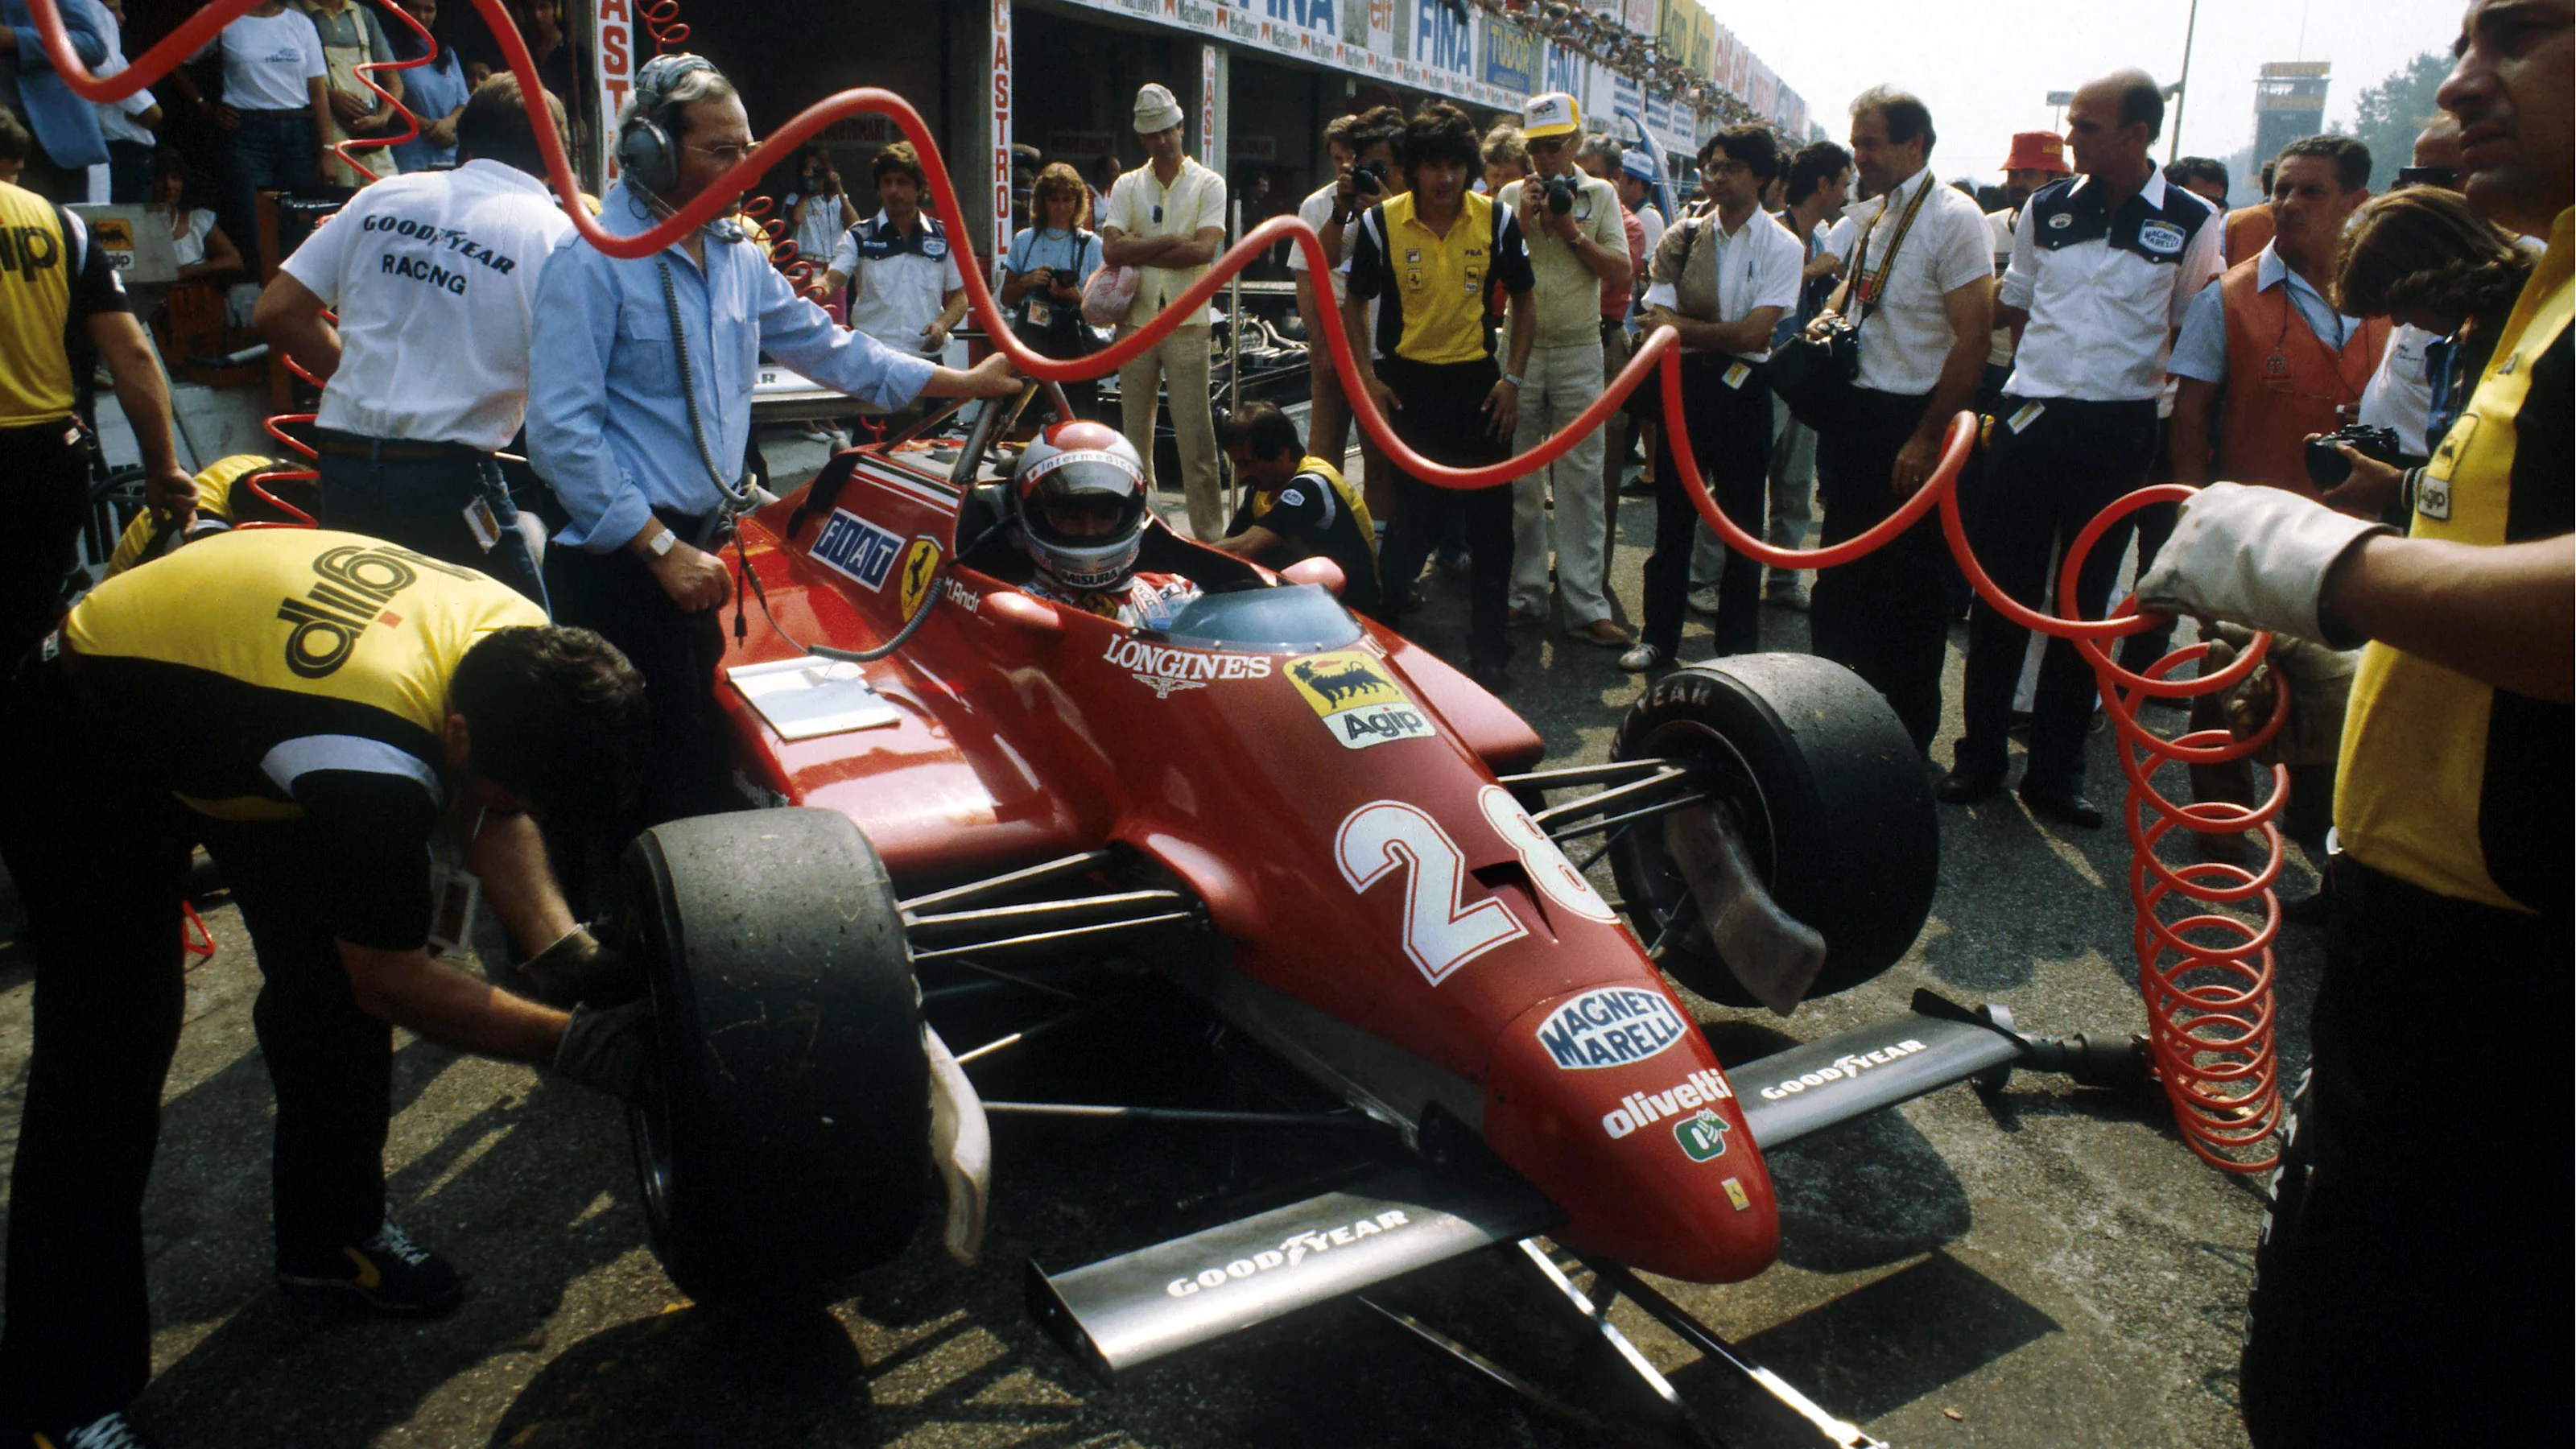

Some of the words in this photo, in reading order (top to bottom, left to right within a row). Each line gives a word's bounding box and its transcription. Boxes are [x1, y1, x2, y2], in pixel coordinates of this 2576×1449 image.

[1178, 0, 1214, 27] Marlboro
[1229, 10, 1257, 39] Marlboro
[1417, 0, 1472, 76] FINA
[1492, 25, 1530, 75] TUDOR
[994, 0, 1009, 255] CASTROL
[364, 215, 516, 275] GOODYEAR
[382, 254, 467, 295] RACNG
[819, 520, 894, 576] FIAT
[1103, 634, 1272, 679] LONGINES
[1344, 706, 1424, 741] Agip
[1335, 785, 1621, 987] 28
[1541, 991, 1682, 1050] MAGNETI
[1542, 1016, 1683, 1067] MARELLI
[1761, 1039, 1926, 1100] GOODYEAR
[1602, 1068, 1732, 1139] olivetti
[1167, 1210, 1410, 1297] GOODYEAR
